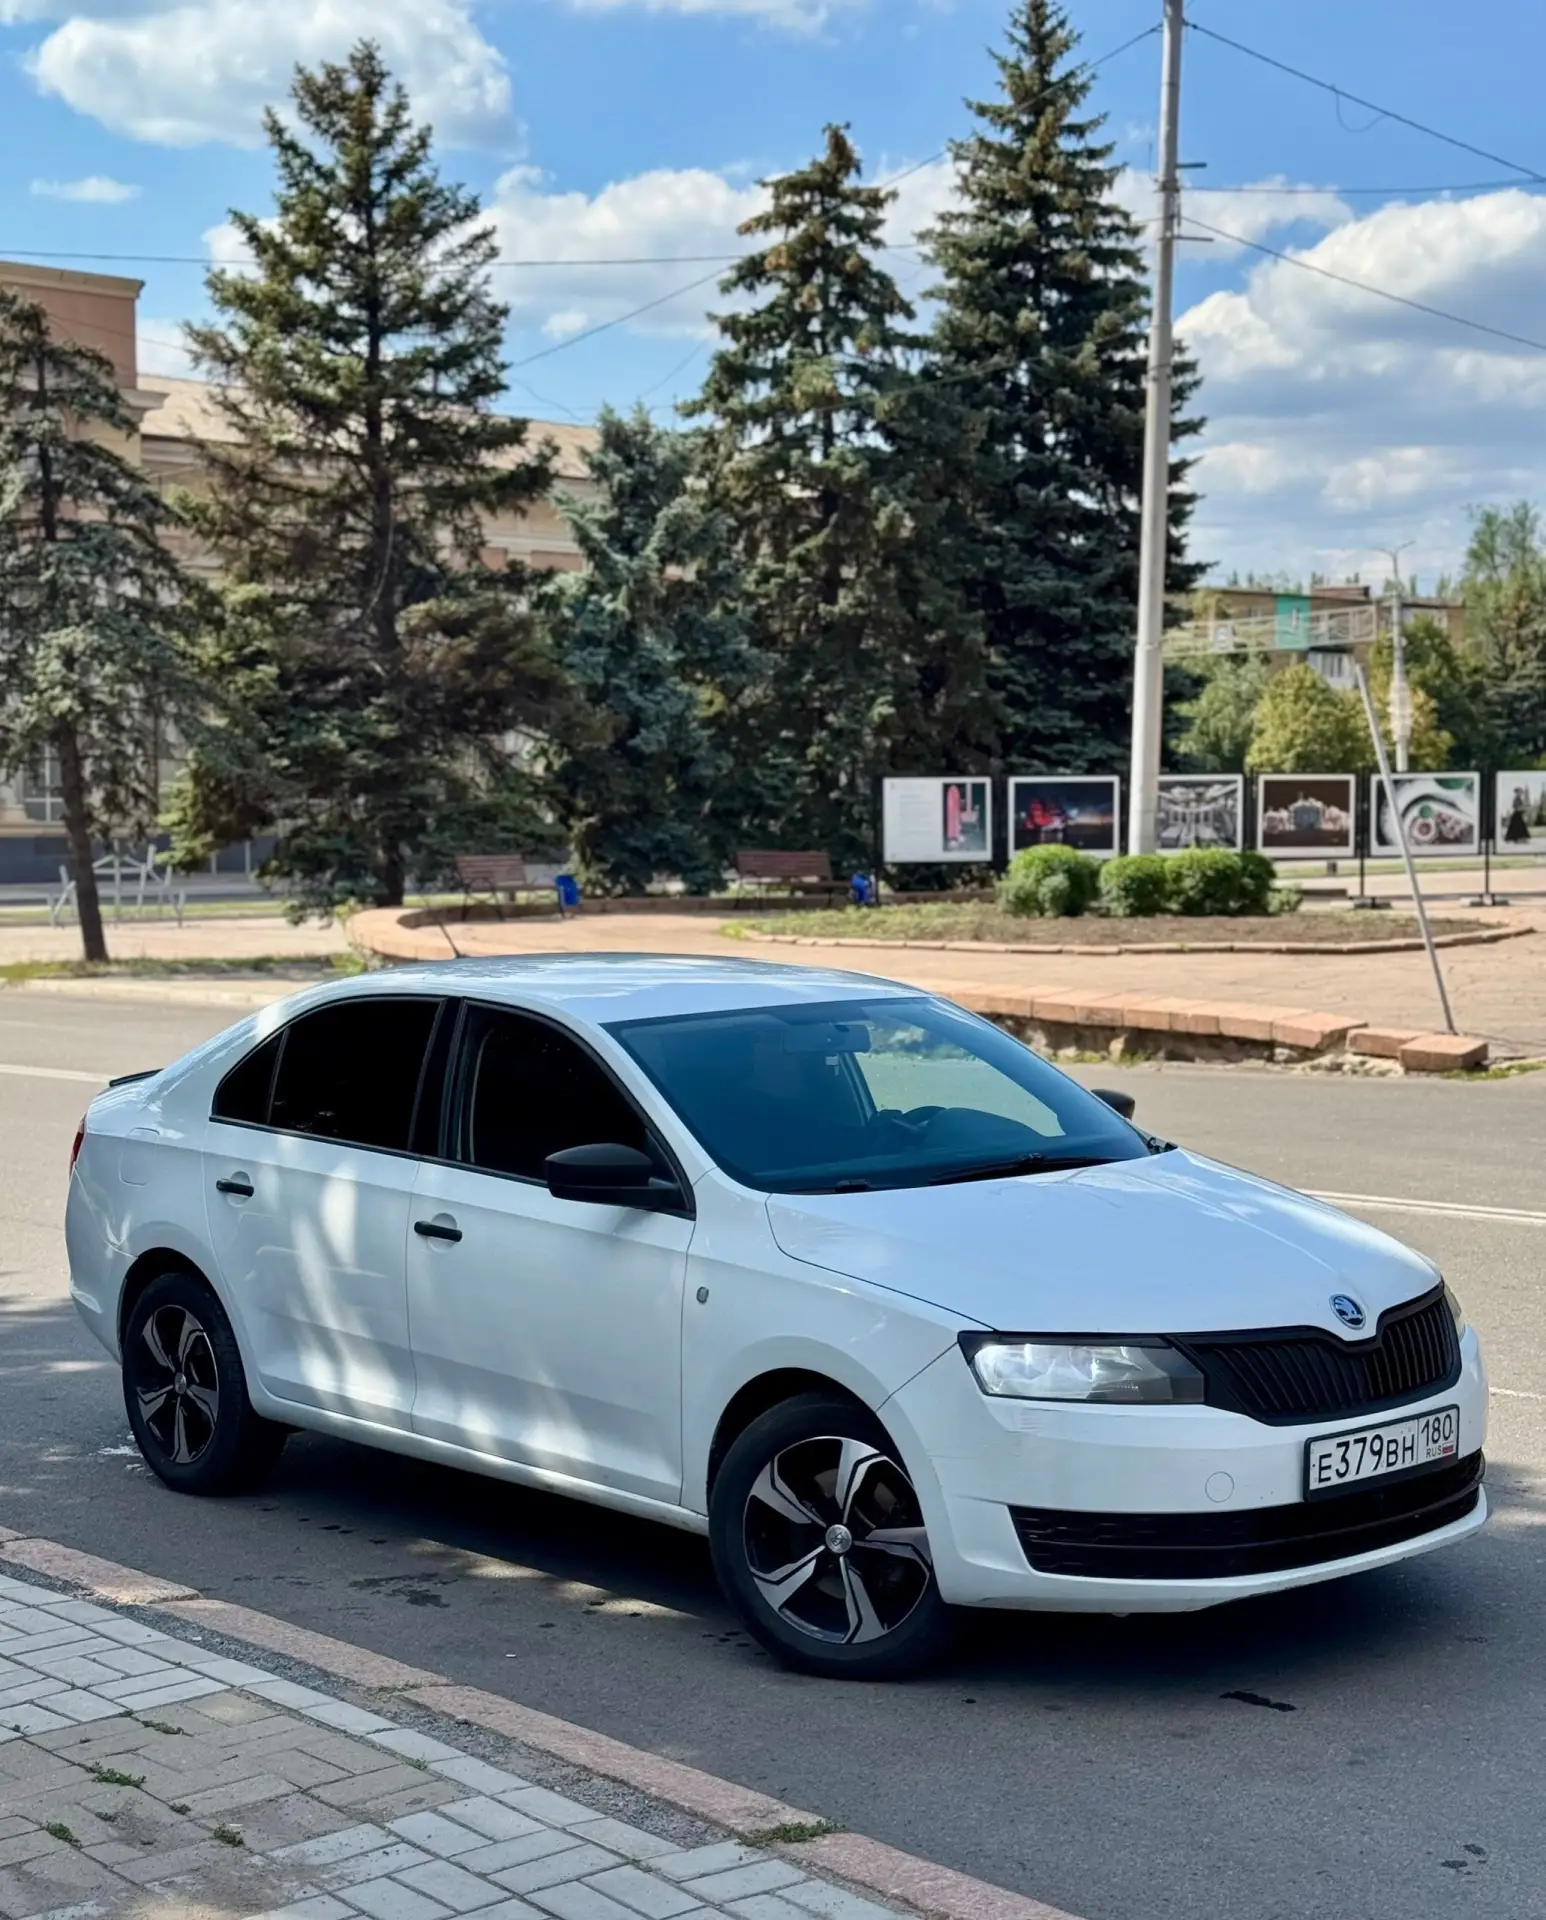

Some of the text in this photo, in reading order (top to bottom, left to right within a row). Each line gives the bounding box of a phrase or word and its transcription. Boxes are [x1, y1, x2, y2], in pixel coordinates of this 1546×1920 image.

[1317, 1413, 1452, 1484] Е379ВН 180
[1425, 1447, 1442, 1459] RUS
